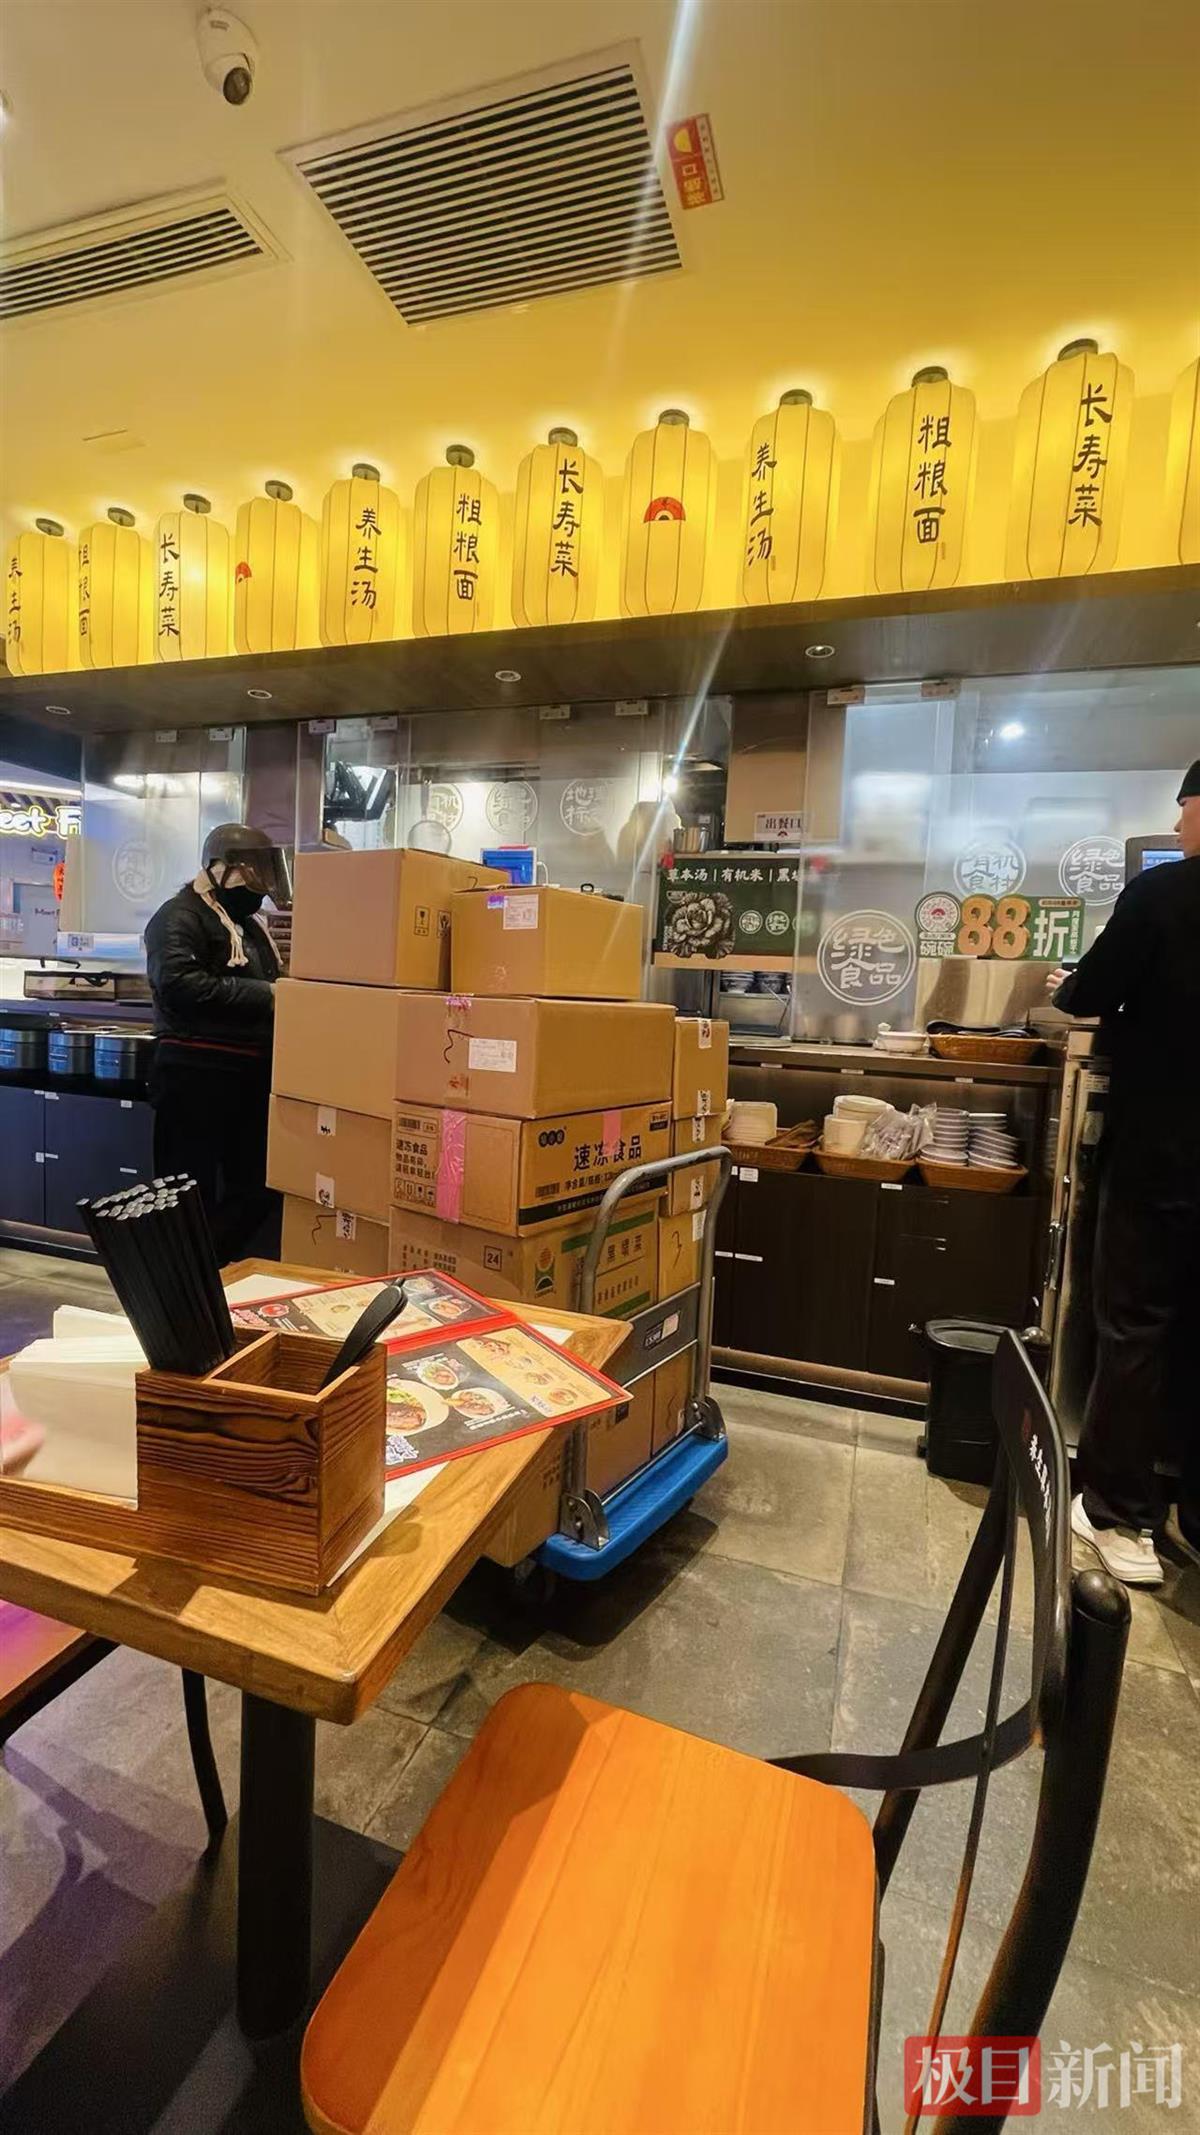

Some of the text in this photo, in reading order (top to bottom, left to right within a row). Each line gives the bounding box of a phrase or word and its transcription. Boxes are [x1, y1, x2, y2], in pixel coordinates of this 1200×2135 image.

[747, 442, 777, 567] 养生汤
[912, 414, 952, 544] 粗粮面
[1067, 383, 1112, 528] 长寿菜
[351, 508, 382, 610] 养生汤
[453, 492, 482, 601] 粗粮面
[550, 458, 584, 578] 长寿菜
[158, 533, 180, 637] 长寿菜
[396, 1139, 429, 1156] 速冻食品
[487, 1252, 499, 1265] 24
